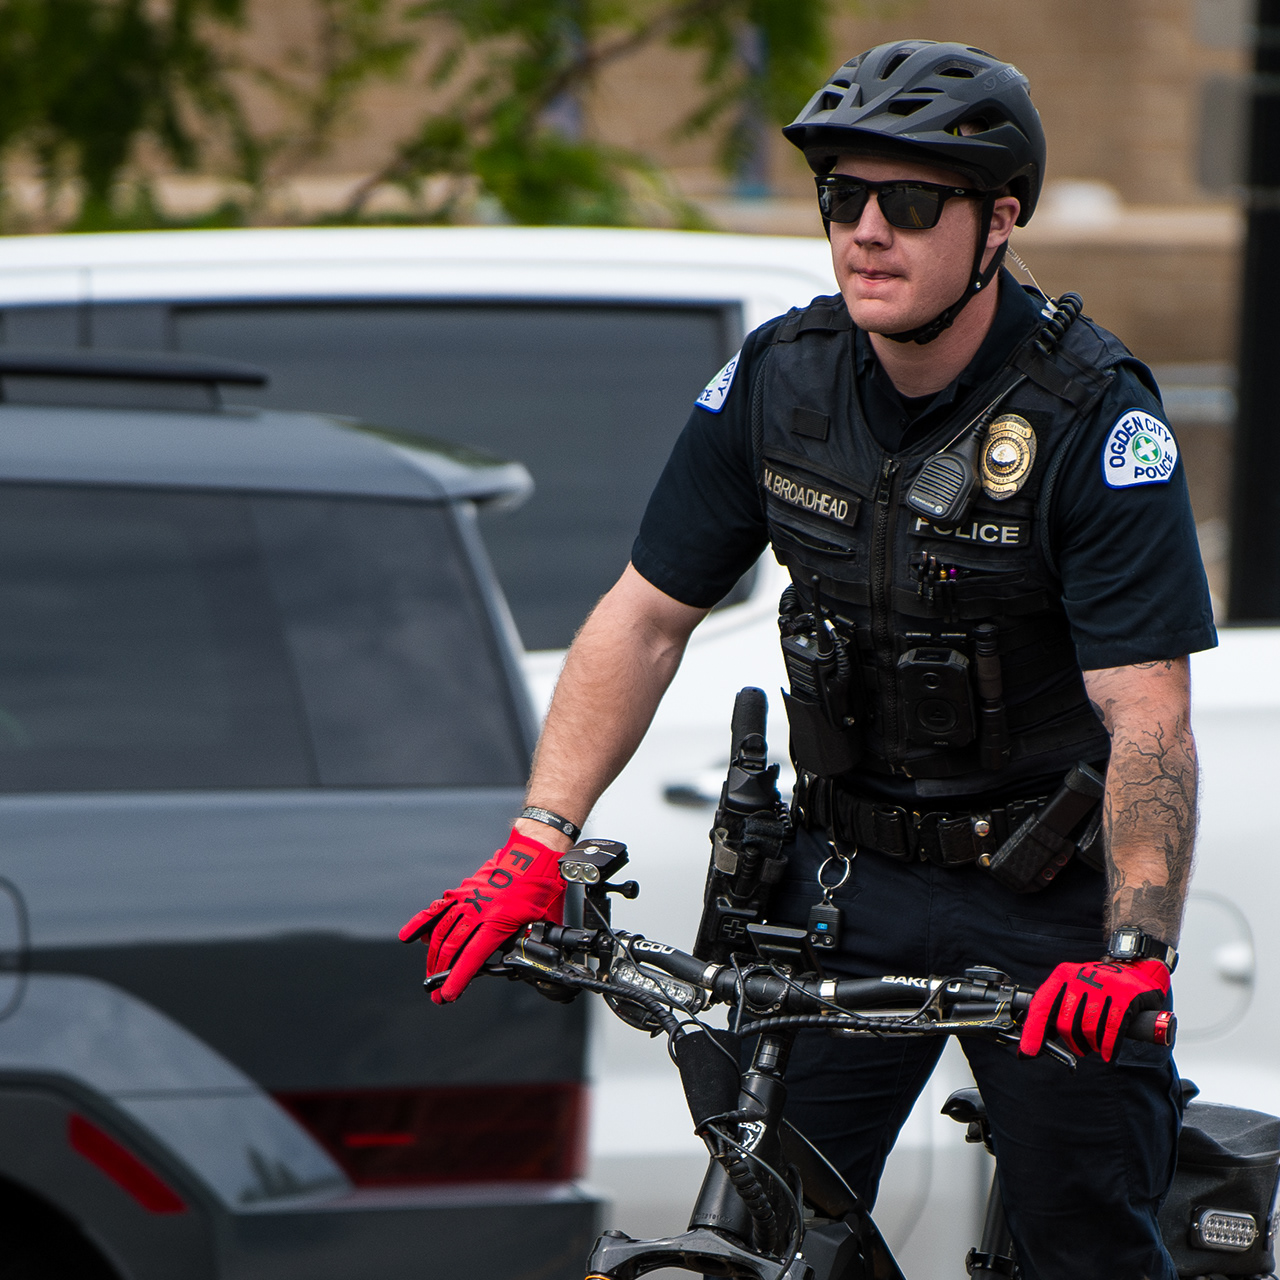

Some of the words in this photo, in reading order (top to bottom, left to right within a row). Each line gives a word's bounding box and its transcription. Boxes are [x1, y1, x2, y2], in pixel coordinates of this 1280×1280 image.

[1109, 416, 1144, 468] OGDEN
[1145, 418, 1172, 443] CITY
[1134, 451, 1173, 478] POLICE
[463, 849, 535, 914] FOX
[881, 975, 962, 993] BAKCU
